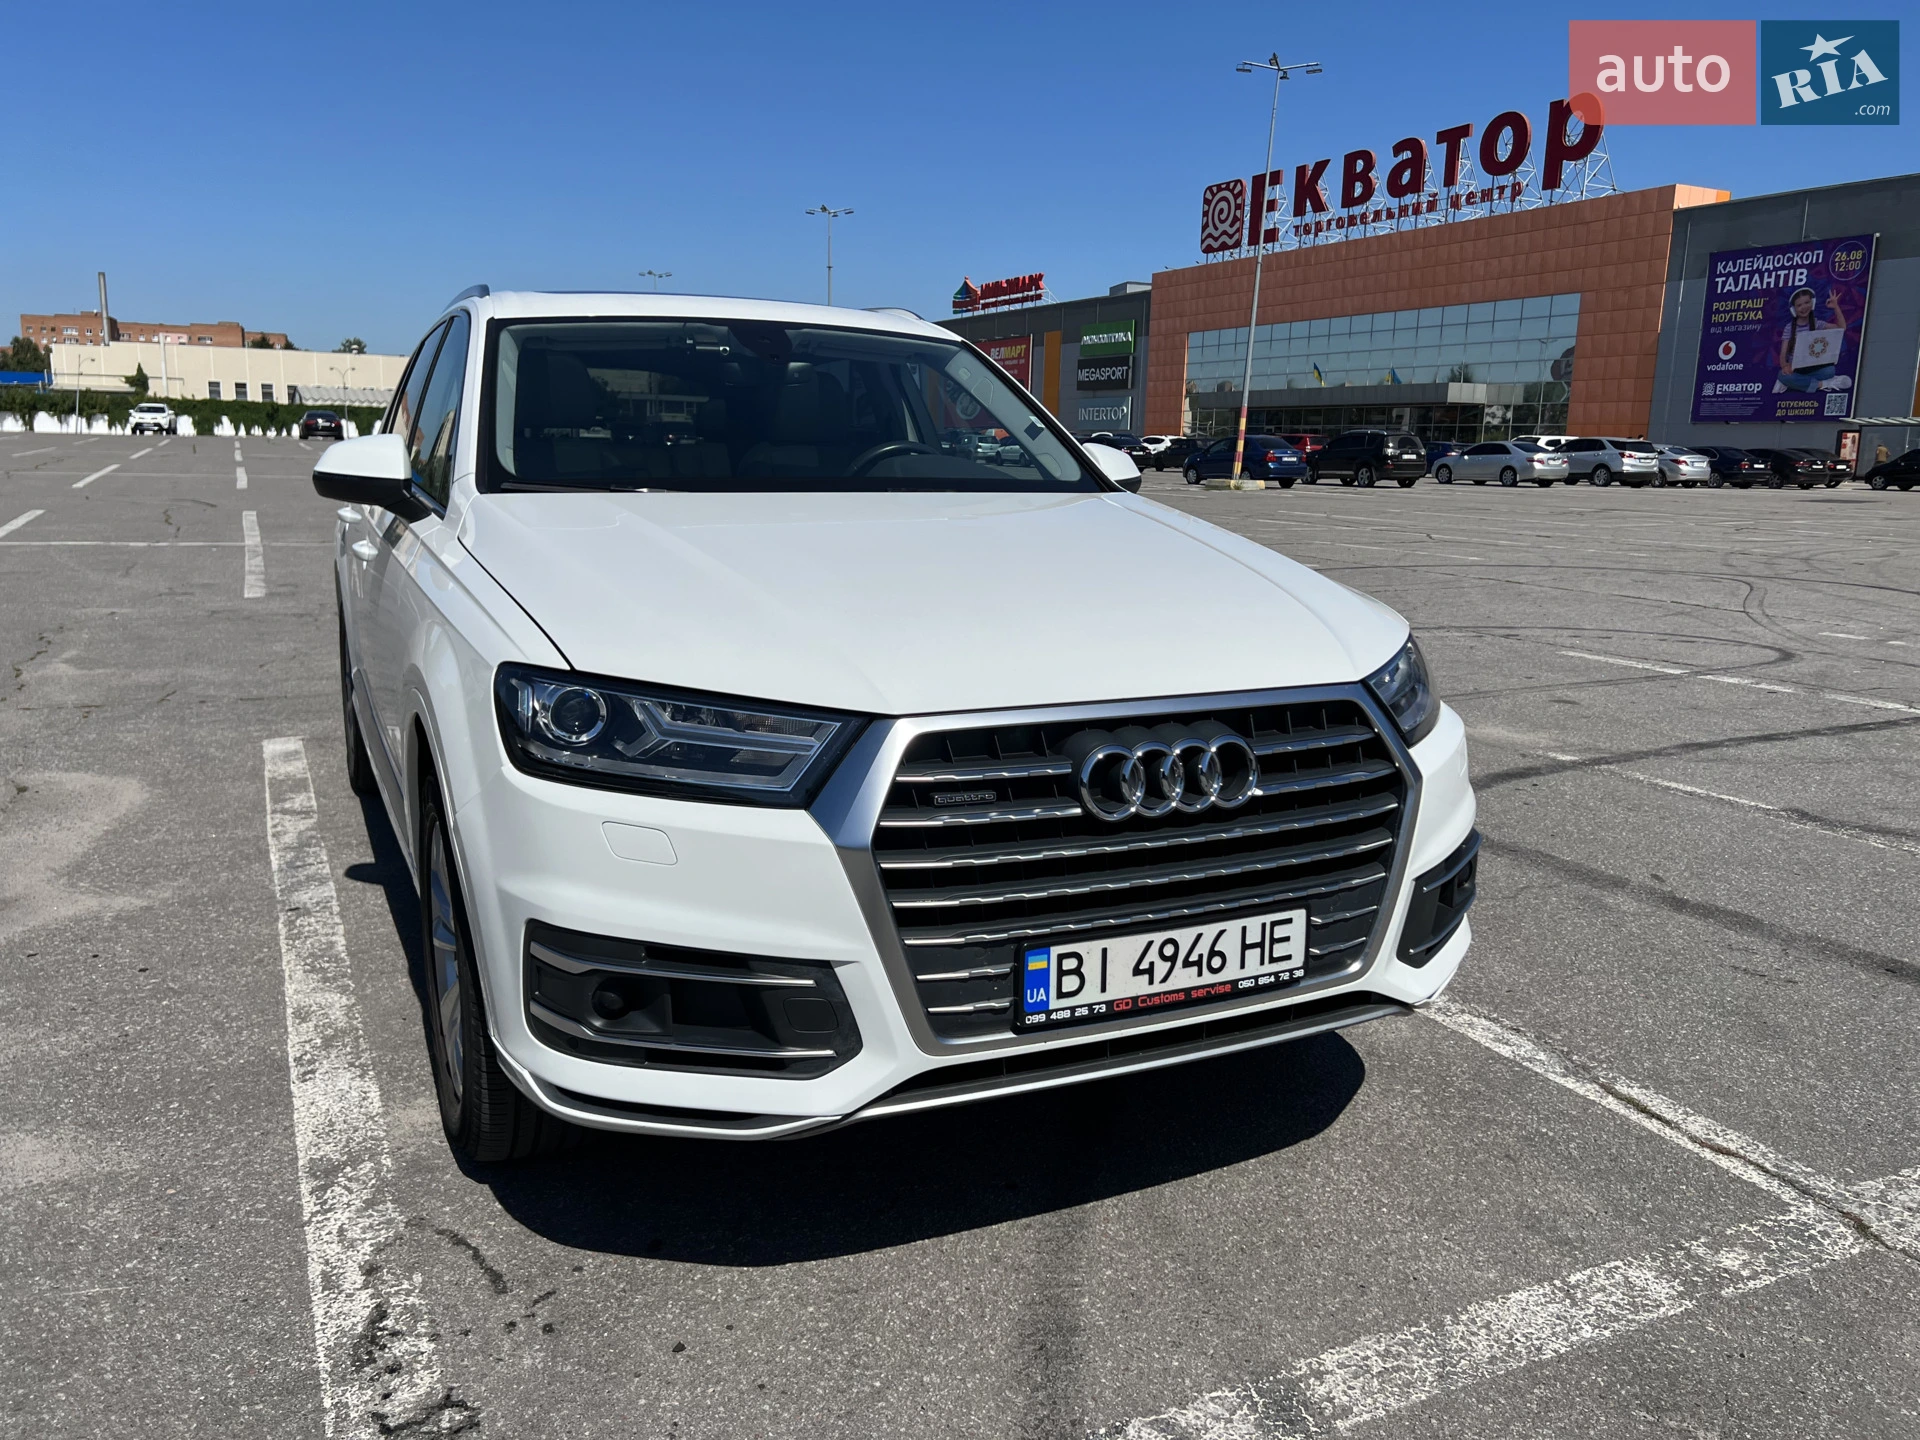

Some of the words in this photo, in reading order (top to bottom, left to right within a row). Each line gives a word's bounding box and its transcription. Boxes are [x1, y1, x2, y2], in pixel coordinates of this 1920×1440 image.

[1293, 192, 1439, 238] торговельний
[1450, 181, 1523, 210] центр
[1716, 250, 1824, 275] КАЛЕЙДОСКОП
[1834, 260, 1861, 272] 12:00
[1715, 269, 1808, 294] ТАЛАНТІВ
[1711, 310, 1763, 323] НОУТБУКА
[1710, 326, 1722, 334] від
[1724, 323, 1762, 333] магазину
[991, 344, 1027, 360] ВЕЛМАРТ
[1077, 366, 1129, 381] MEGASPORT
[1706, 362, 1744, 371] vodafone
[1777, 400, 1819, 409] ГОТУЄМОСЬ
[1078, 406, 1128, 421] INTERTOP
[1776, 409, 1787, 417] ДО
[1788, 408, 1815, 417] ШКОЛИ
[937, 794, 994, 804] quattro
[1056, 947, 1108, 1000] BI
[1132, 928, 1228, 986] 4946
[1240, 917, 1294, 970] HE
[1025, 1013, 1046, 1024] 099
[1050, 1009, 1071, 1020] 488
[1074, 1006, 1089, 1017] 25
[1092, 1003, 1107, 1014] 73
[1138, 990, 1185, 1008] Customs
[1191, 983, 1231, 998] servise
[1238, 979, 1255, 989] 050
[1258, 975, 1275, 985] 854
[1278, 972, 1290, 981] 72
[1027, 986, 1047, 1004] UA
